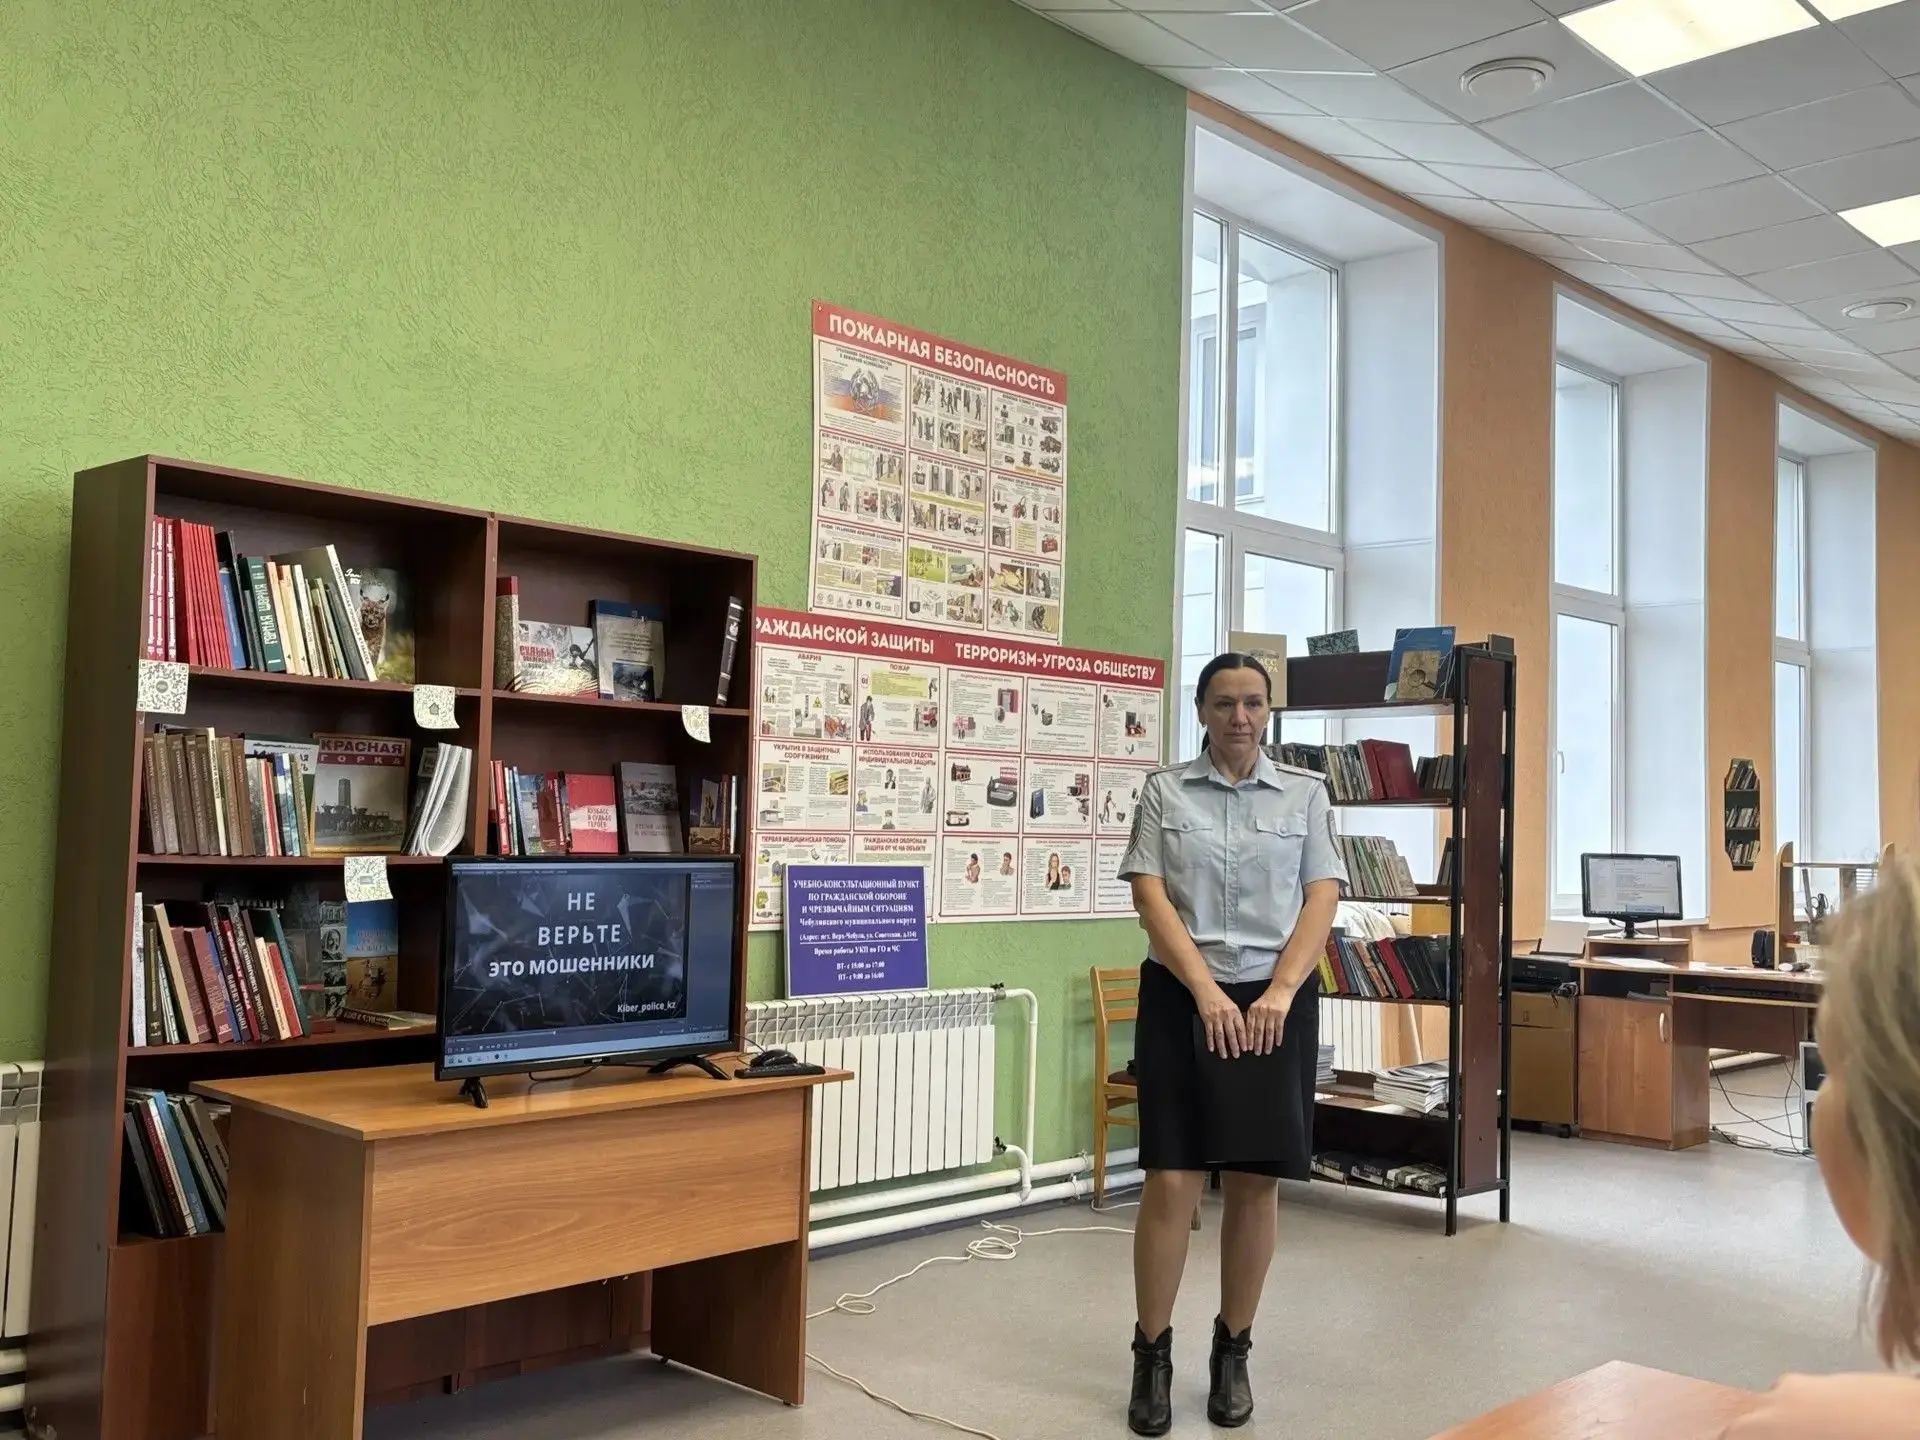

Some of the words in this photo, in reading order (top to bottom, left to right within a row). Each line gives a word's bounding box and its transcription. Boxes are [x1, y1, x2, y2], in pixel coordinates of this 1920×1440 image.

[829, 314, 931, 358] ПОЖАРНАЯ
[934, 347, 1056, 395] БЕЗОПАСНОСТЬ
[871, 629, 934, 655] ЗАЩИТЫ
[797, 653, 822, 662] АВАРИЯ
[955, 642, 1091, 674] ТЕРРОРИЗМ-УГРОЗА
[1094, 660, 1156, 680] ОБЩЕСТВУ
[889, 663, 911, 672] ПОЖАР
[320, 738, 404, 755] КРАСНАЯ
[807, 746, 840, 754] ЗАЩИТНЫХ
[784, 752, 829, 760] СООРУЖЕНИЯХ
[862, 749, 910, 758] ИСПОЛЬЗОВАНИЕ
[911, 751, 933, 759] СРЕДСТВ
[319, 754, 401, 765] ГОРКА
[858, 756, 912, 765] ИНДИВИДУАЛЬНОЙ
[913, 758, 936, 766] ЗАЩИТЫ
[761, 835, 782, 843] ПЕРВАЯ
[783, 836, 822, 844] МЕДИЦИНСКАЯ
[823, 836, 846, 844] ПОМОЩЬ
[863, 837, 899, 845] ГРАЖДАНСКАЯ
[863, 844, 884, 852] ЗАЩИТА
[793, 879, 897, 889] УЧЕБНО-КОНСУЛЬТАЦИОННЫЙ
[898, 879, 919, 888] ПУНКТ
[808, 892, 819, 901] ПО
[821, 891, 873, 901] ГРАЖДАНСКОЙ
[874, 892, 907, 900] ОБОРОНЕ
[567, 892, 595, 911] НЕ
[801, 905, 807, 913] И
[808, 903, 869, 913] ЧРЕЗВЫЧАЙНЫМ
[871, 903, 913, 913] СИТУАЦИЯМ
[844, 918, 895, 928] муниципального
[896, 917, 916, 927] округа
[537, 923, 622, 946] ВЕРЬТЕ
[813, 947, 832, 956] Время
[833, 946, 853, 956] работы
[854, 946, 869, 954] УКП
[891, 945, 900, 953] ЧС
[617, 1000, 677, 1013] Kiber_police_kz
